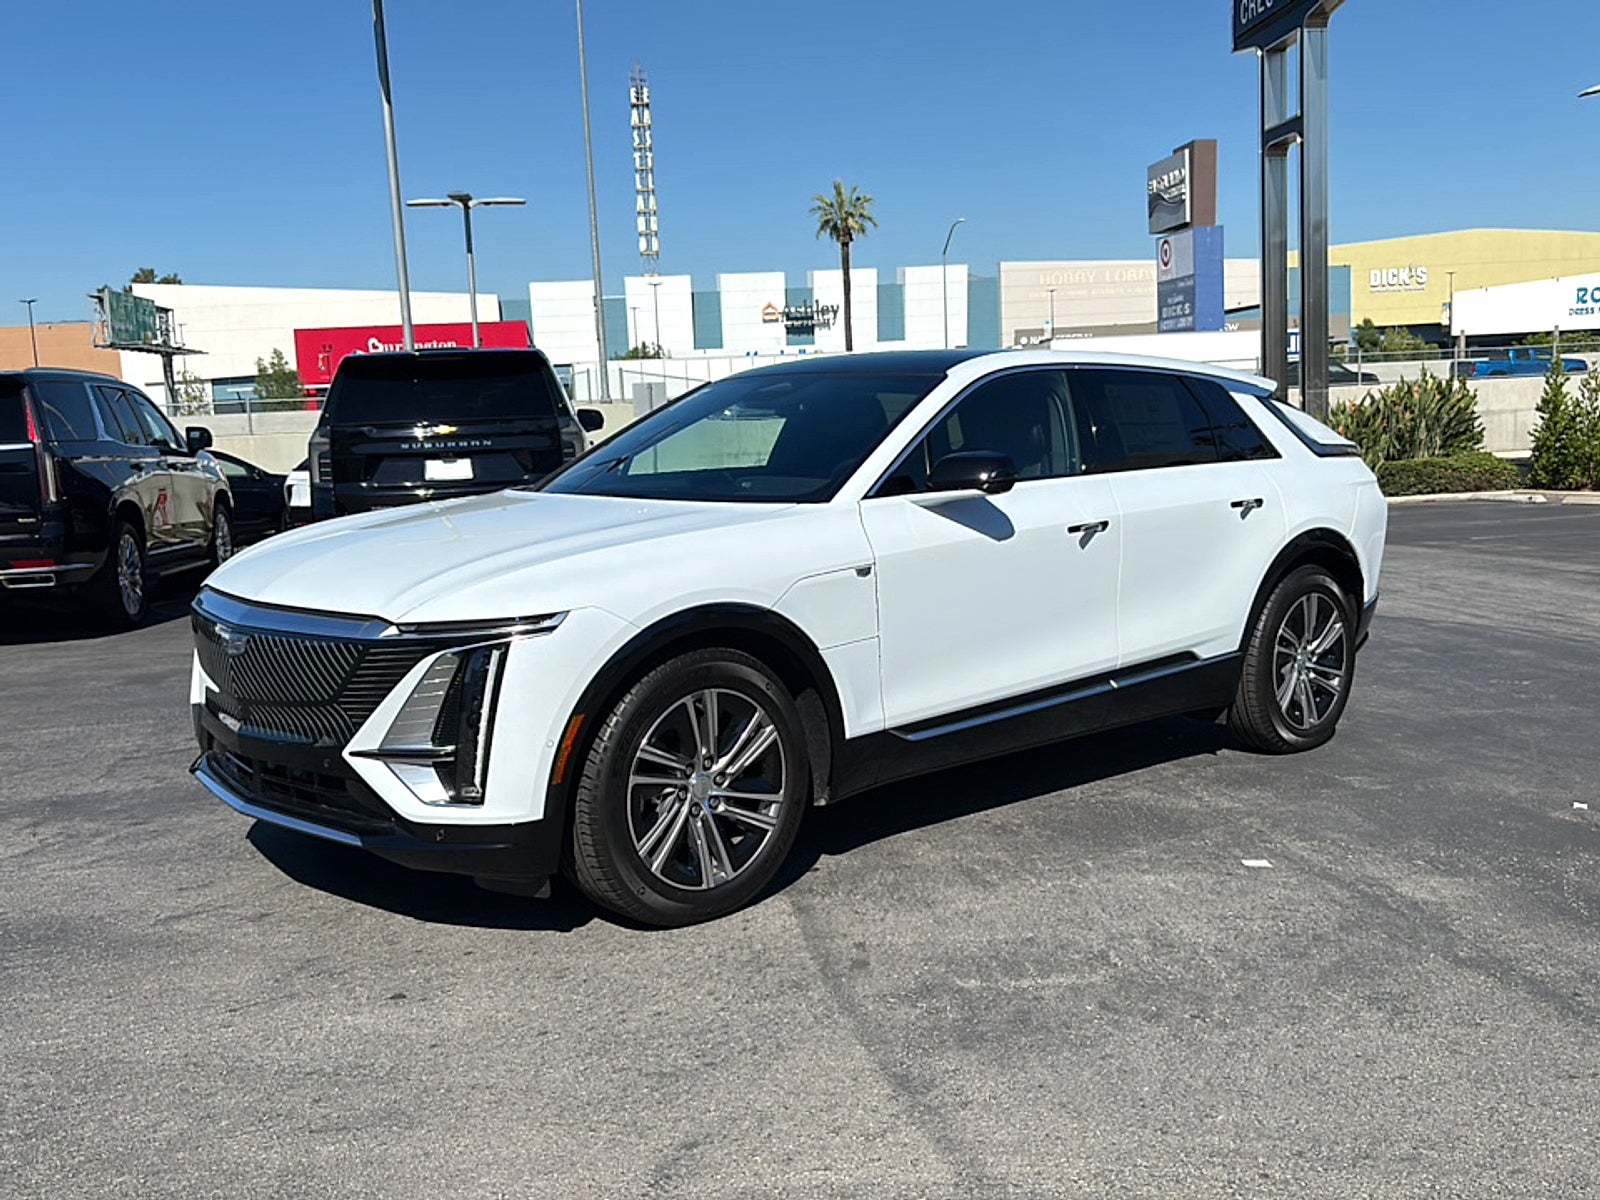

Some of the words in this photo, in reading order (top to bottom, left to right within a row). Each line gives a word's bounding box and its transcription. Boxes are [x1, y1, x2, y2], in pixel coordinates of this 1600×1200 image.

[1239, 0, 1273, 24] CRE
[1370, 265, 1427, 287] DICK'S
[778, 299, 839, 326] Ashley
[400, 439, 492, 450] SUBURBAN
